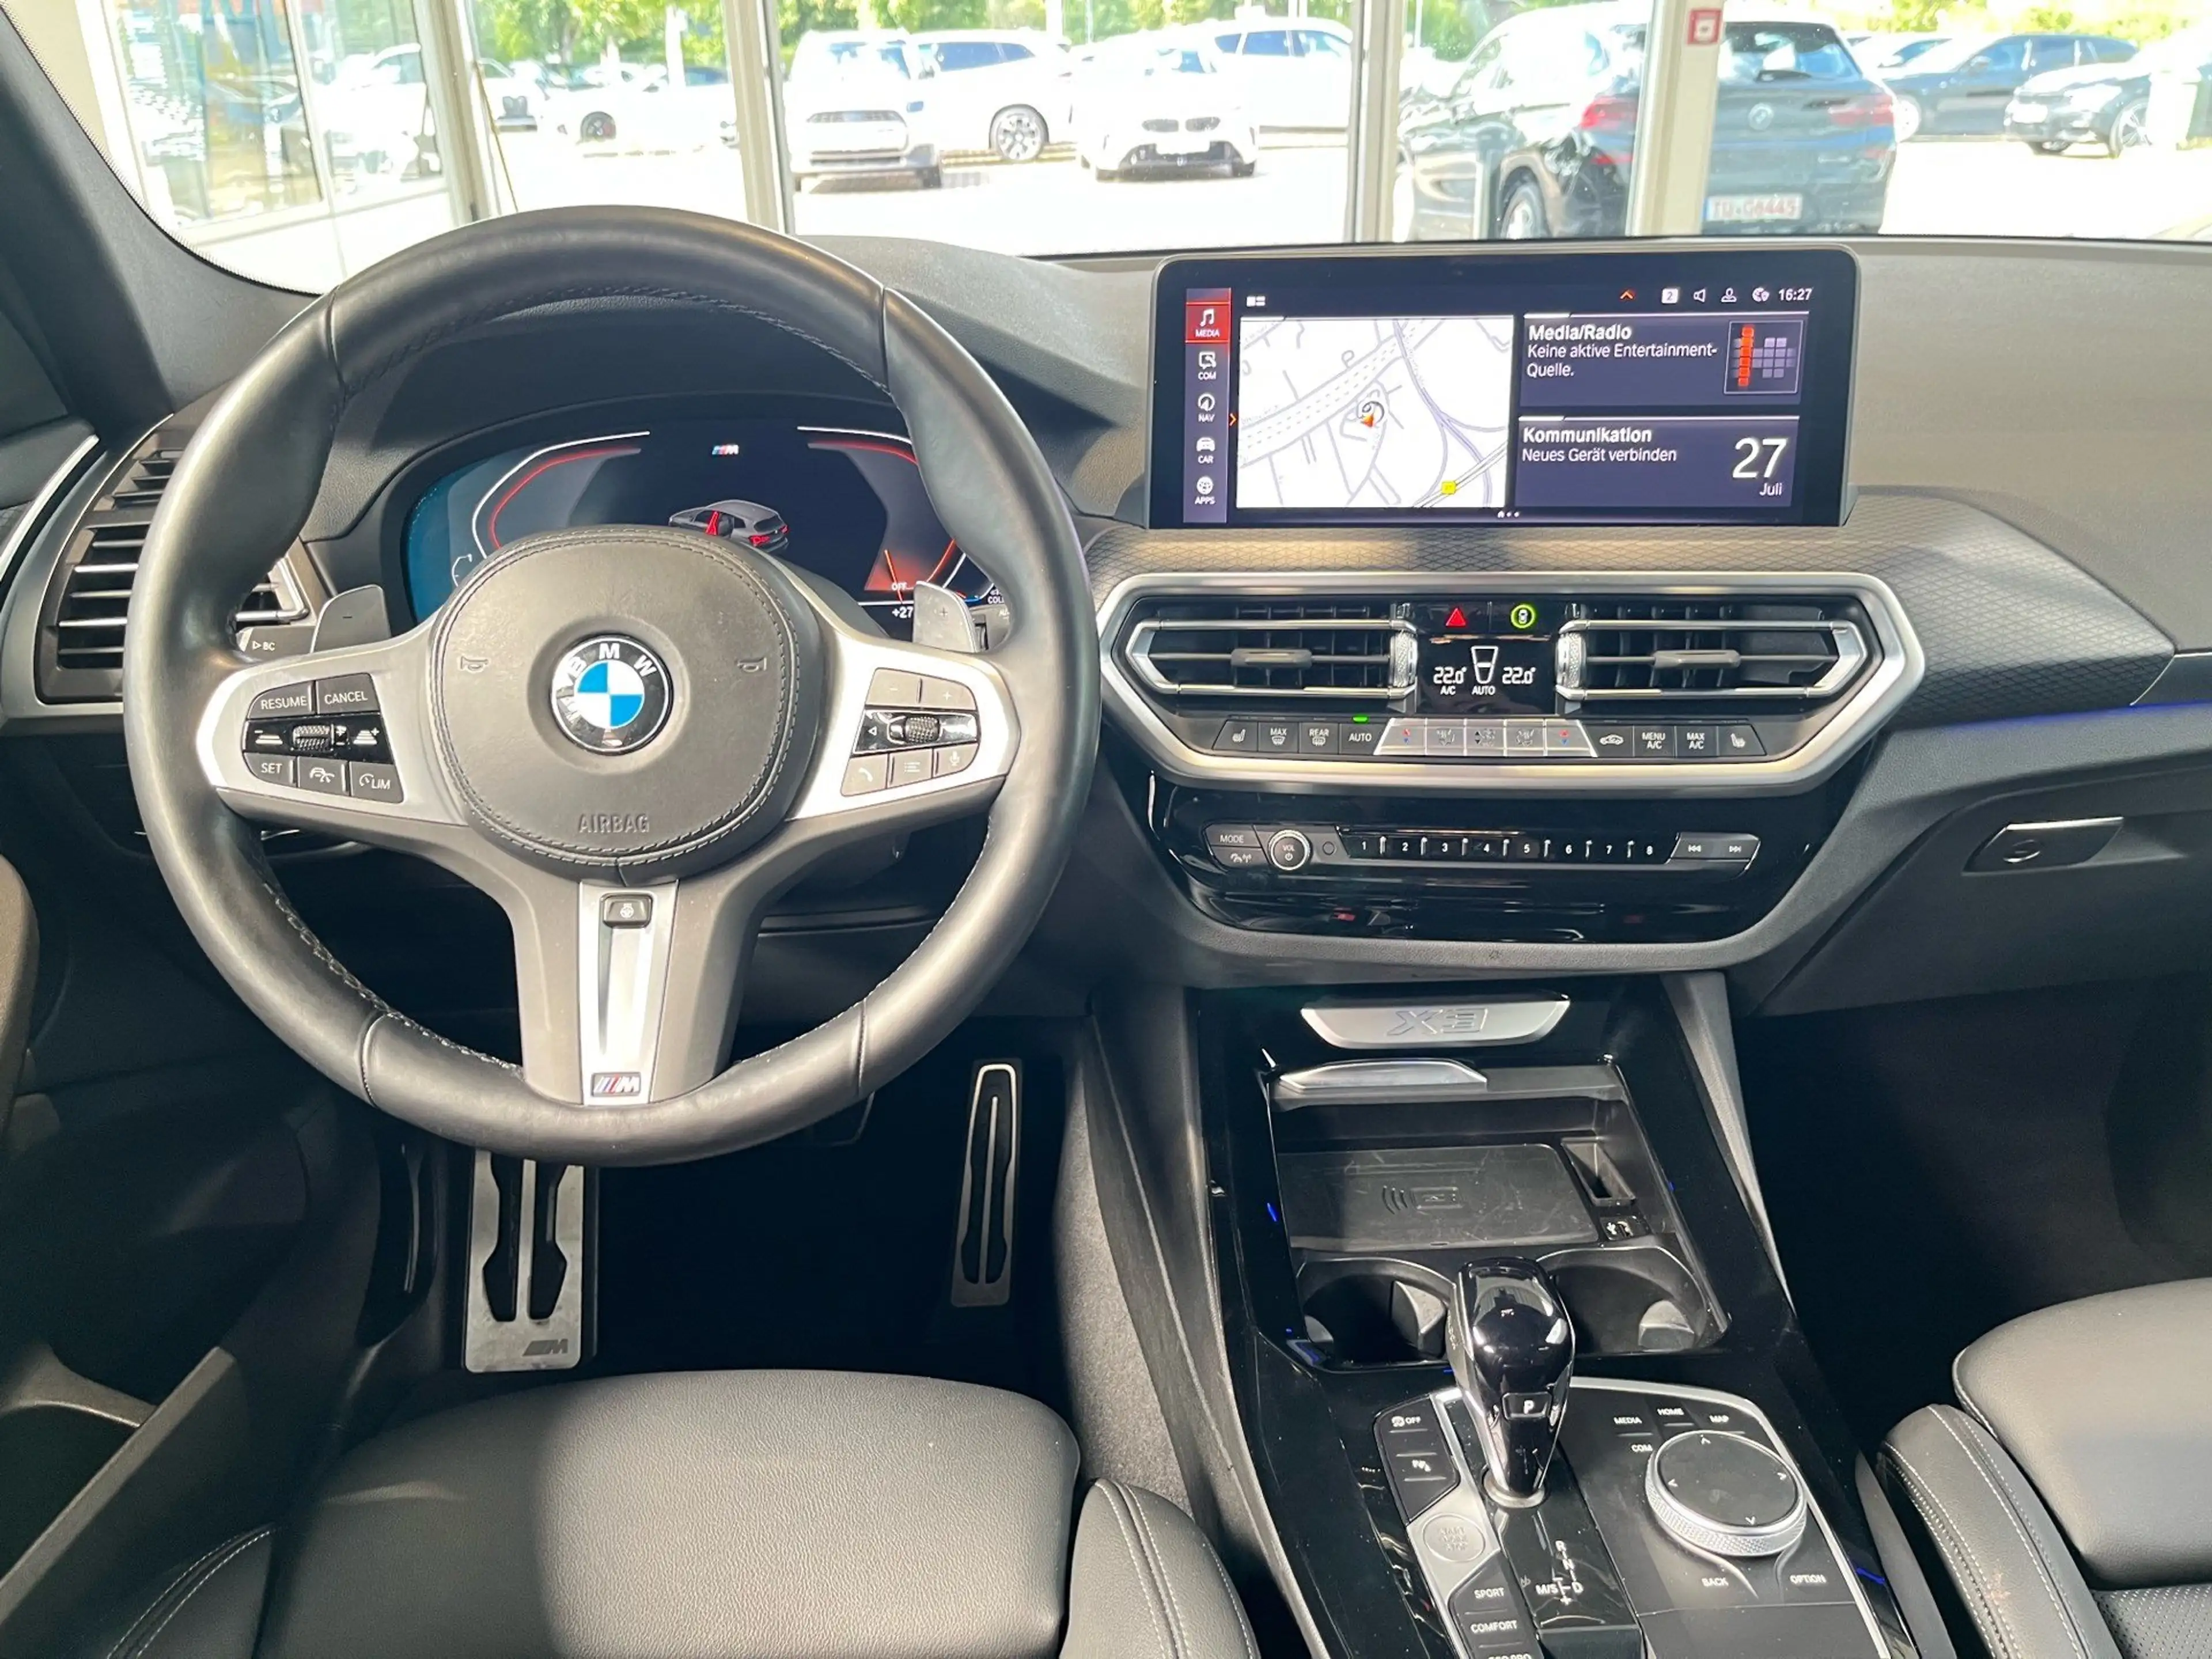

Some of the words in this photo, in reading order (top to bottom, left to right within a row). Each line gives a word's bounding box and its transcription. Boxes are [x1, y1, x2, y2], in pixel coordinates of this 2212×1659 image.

[1778, 287, 1813, 301] 16:27
[1195, 329, 1220, 338] MEDIA
[1528, 324, 1631, 340] Media/Radio
[1527, 344, 1566, 358] Keine
[1570, 343, 1609, 357] aktive
[1613, 342, 1717, 357] Entertainment-
[1198, 371, 1216, 380] COM
[1527, 363, 1574, 378] Quelle.
[1198, 414, 1215, 422] NAV
[1522, 427, 1652, 443] Kommunikation
[1198, 455, 1214, 464] CAR
[1522, 448, 1565, 462] Neues
[1568, 447, 1605, 462] Gerät
[1608, 447, 1676, 462] verbinden
[1732, 438, 1787, 478] 27
[1759, 482, 1782, 496] Juli
[1194, 496, 1215, 505] APPS
[891, 582, 907, 590] OFF
[263, 641, 275, 651] BC
[568, 643, 657, 677] BMW
[1440, 686, 1456, 695] A/C
[1472, 686, 1495, 695] AUTO
[324, 691, 368, 704] CANCEL
[261, 696, 308, 710] RESUME
[1270, 728, 1287, 736] MAX
[1309, 729, 1329, 737] REAR
[1642, 732, 1666, 740] MENU
[1687, 732, 1705, 740] MAX
[1349, 733, 1372, 742] AUTO
[1647, 741, 1662, 749] A/C
[1688, 741, 1705, 749] A/C
[261, 763, 282, 774] SET
[372, 778, 391, 790] LIM
[578, 814, 650, 834] AIRBAG
[1219, 835, 1244, 843] MODE
[1362, 841, 1366, 850] 1
[1402, 842, 1408, 851] 2
[1442, 843, 1448, 852] 3
[1483, 843, 1490, 853] 4
[1524, 843, 1530, 854] 5
[1565, 844, 1572, 854] 6
[1606, 844, 1612, 855] 7
[1646, 845, 1653, 855] 8
[1387, 1007, 1488, 1036] X3
[1524, 1399, 1535, 1414] P
[1657, 1407, 1684, 1416] HOME
[1405, 1416, 1421, 1425] OFF
[1613, 1416, 1642, 1425] MEDIA
[1709, 1415, 1729, 1423] MAP
[1631, 1444, 1653, 1452] COM
[1555, 1540, 1567, 1551] R
[1562, 1558, 1575, 1570] N
[1701, 1577, 1728, 1586] BACK
[1790, 1574, 1826, 1585] OPTION
[1571, 1581, 1584, 1594] D
[1474, 1587, 1505, 1599] SPORT
[1470, 1619, 1517, 1634] COMFORT
